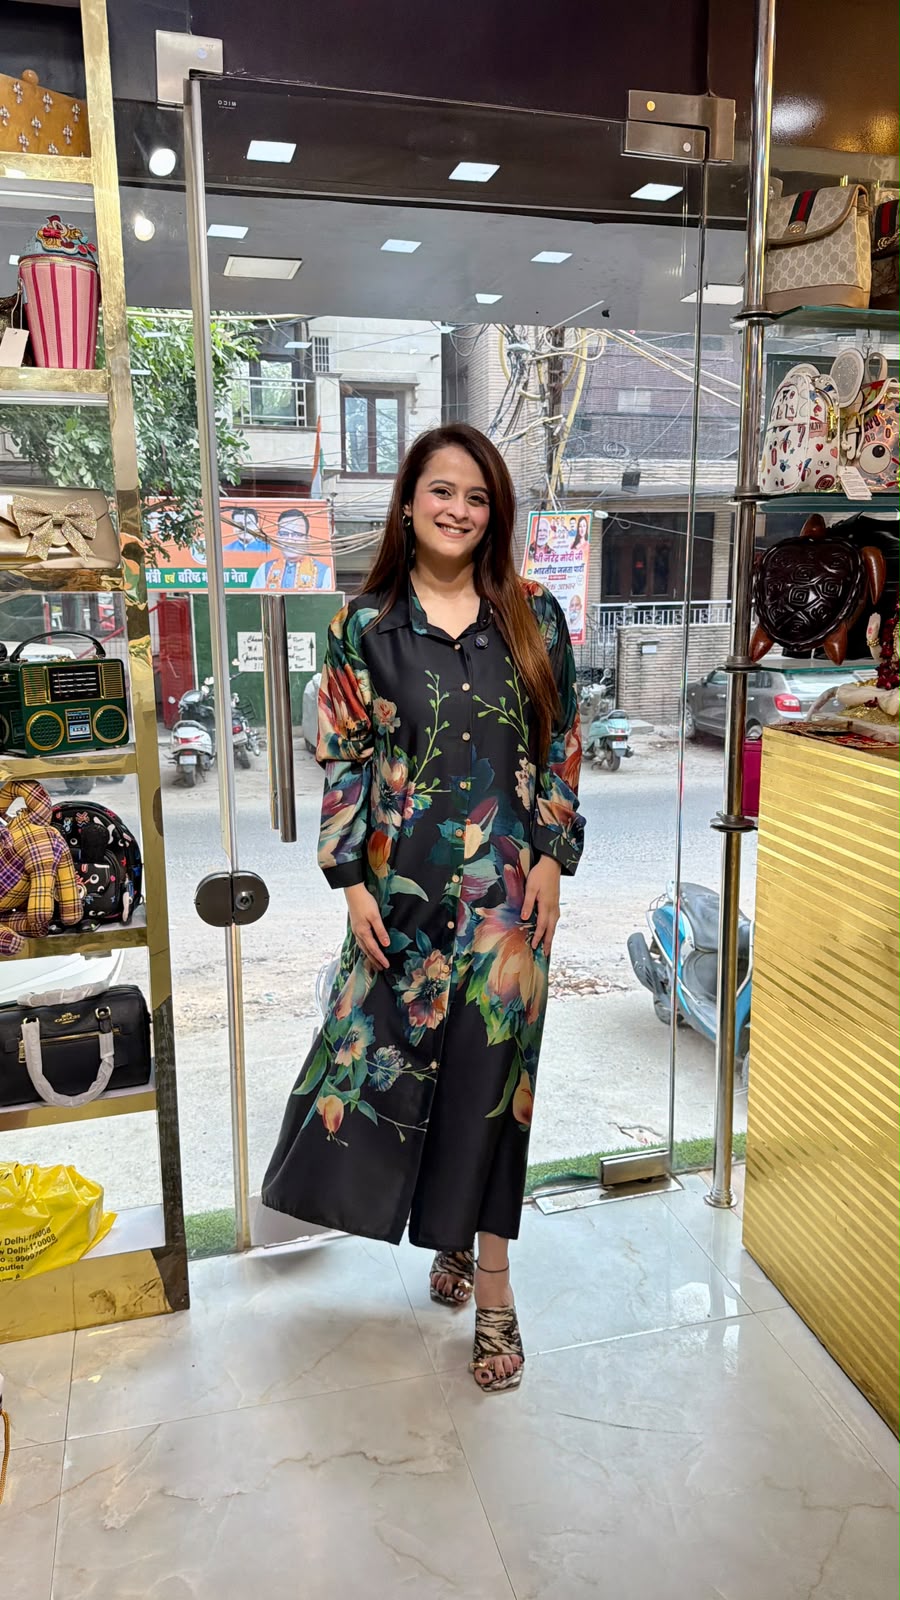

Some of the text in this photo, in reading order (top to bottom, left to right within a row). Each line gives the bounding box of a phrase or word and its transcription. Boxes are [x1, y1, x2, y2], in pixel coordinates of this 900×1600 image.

[534, 564, 556, 575] भारतीय
[164, 572, 175, 584] एवं
[178, 568, 201, 583] वरिष्ठ
[231, 568, 248, 583] नेता
[0, 1264, 24, 1272] outlet
